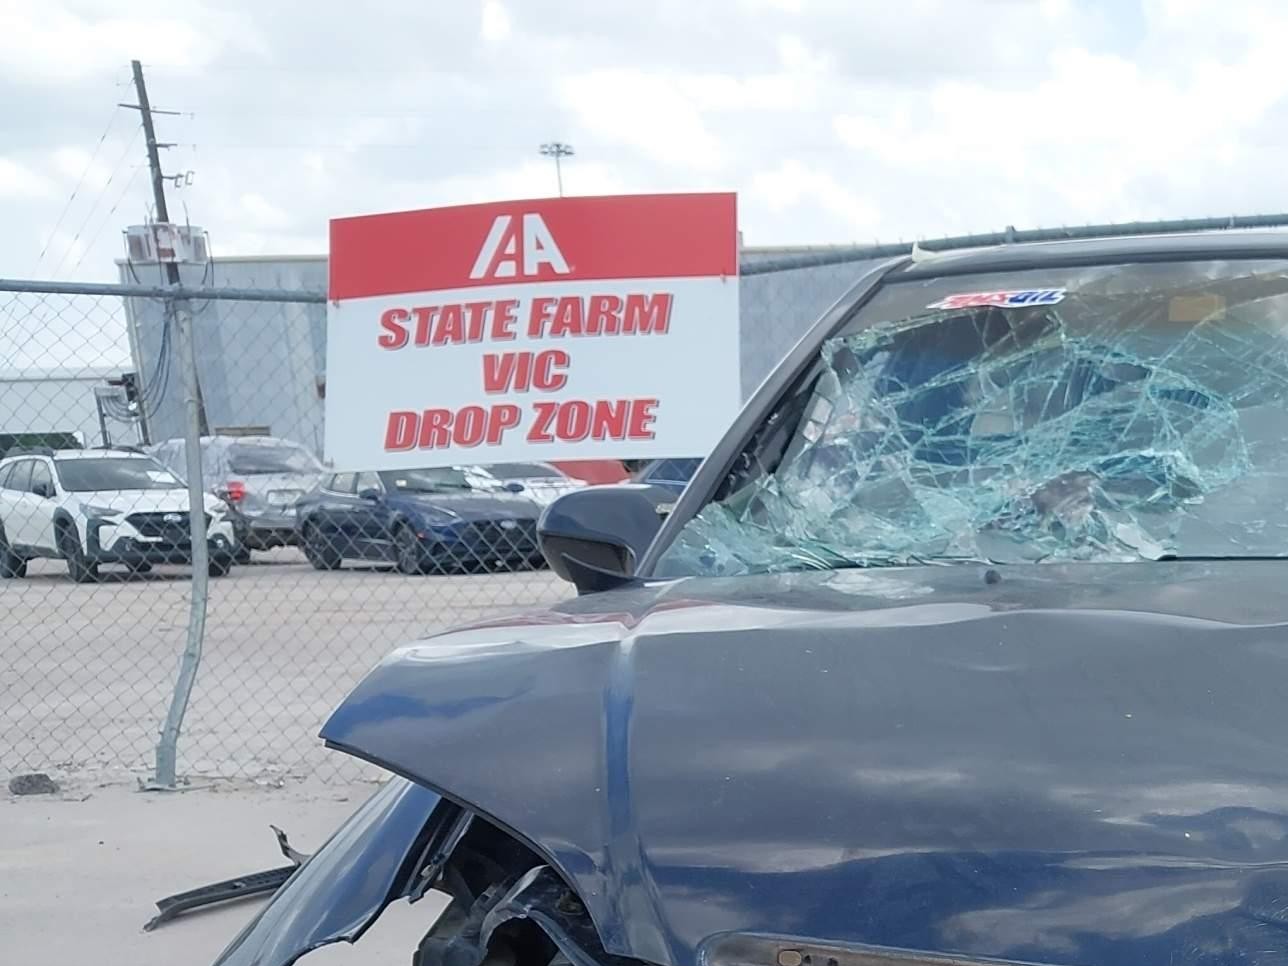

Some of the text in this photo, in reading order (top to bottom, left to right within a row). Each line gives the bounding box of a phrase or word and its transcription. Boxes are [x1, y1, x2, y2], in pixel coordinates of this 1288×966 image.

[377, 293, 673, 350] STATE FARM
[482, 349, 570, 394] VIC
[383, 398, 659, 452] DROP ZONE
